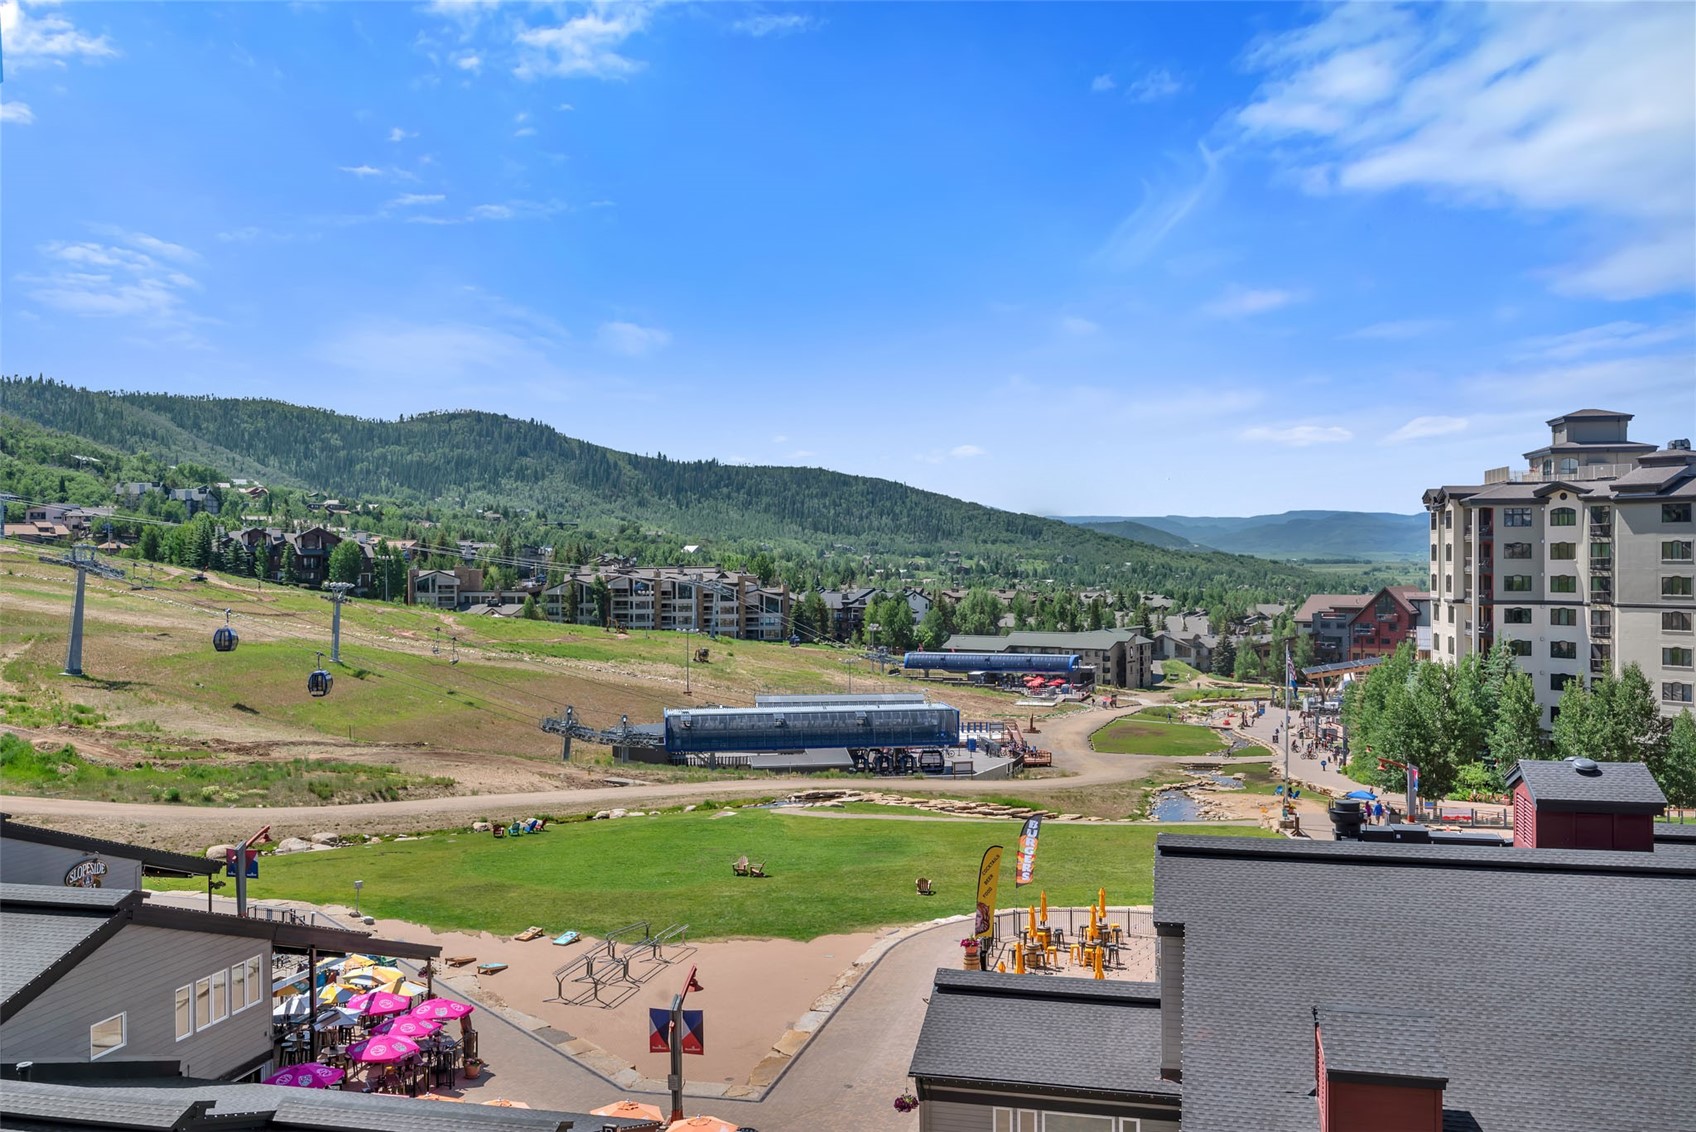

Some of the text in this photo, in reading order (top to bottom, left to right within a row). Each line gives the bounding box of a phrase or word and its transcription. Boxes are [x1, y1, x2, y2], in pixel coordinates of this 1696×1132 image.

[1021, 819, 1039, 881] BURGERS
[69, 862, 106, 883] SLOPESIDE
[982, 854, 1000, 876] COCKTAILS
[983, 874, 994, 886] BEER
[982, 886, 993, 898] FOOD
